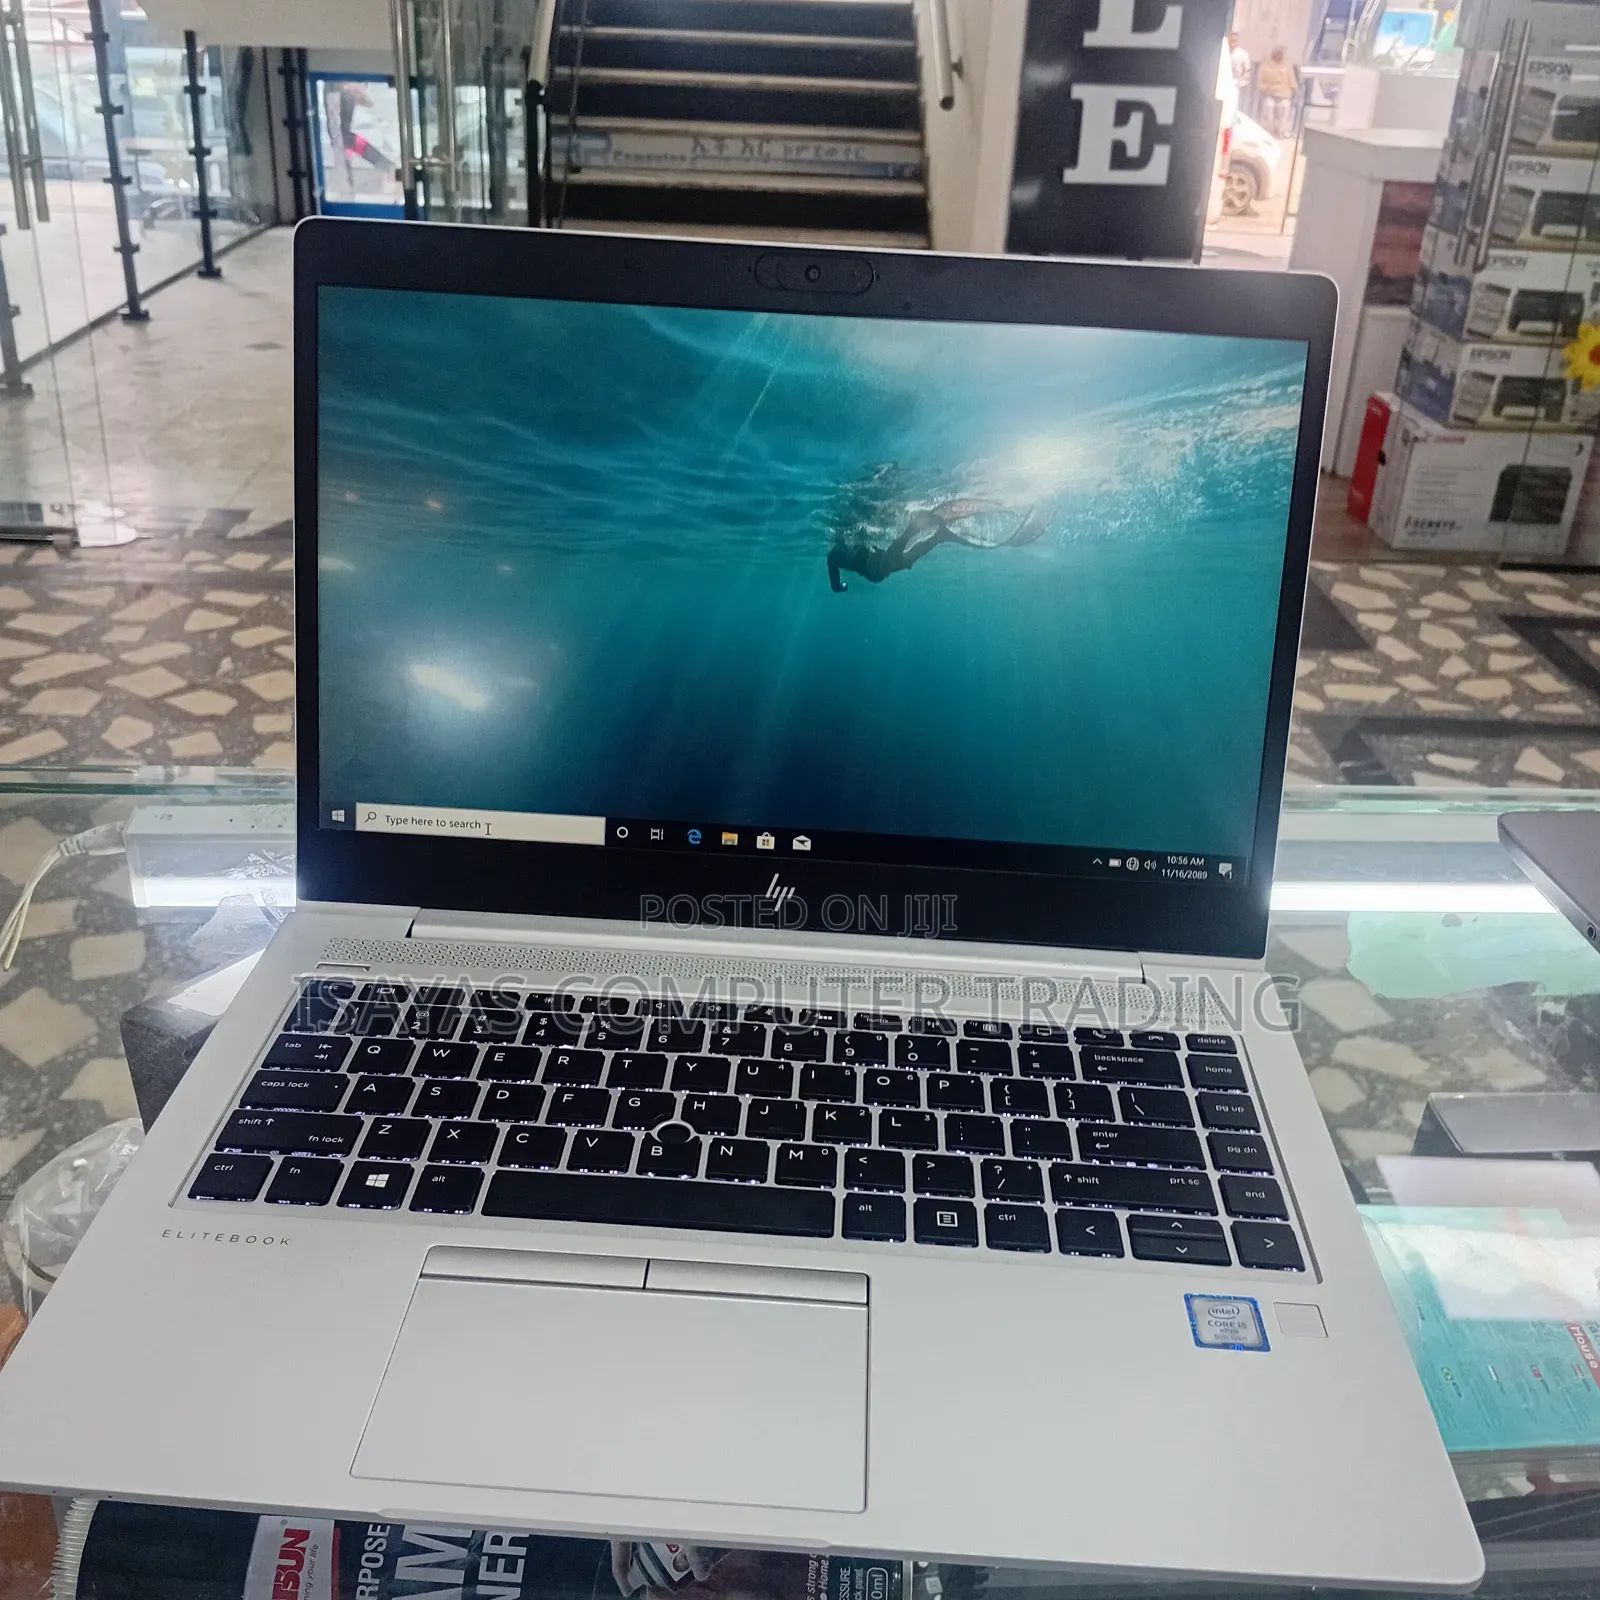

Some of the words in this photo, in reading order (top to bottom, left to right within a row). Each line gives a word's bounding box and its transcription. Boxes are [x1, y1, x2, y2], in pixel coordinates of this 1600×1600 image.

[1527, 60, 1573, 76] EPSON
[1507, 160, 1551, 175] EPSON
[1469, 348, 1512, 363] EPSON
[385, 815, 409, 826] Type
[411, 816, 433, 827] here
[436, 818, 446, 827] to
[449, 818, 481, 830] search
[1166, 855, 1188, 866] 10:56
[1190, 857, 1205, 866] AM
[411, 1021, 422, 1030] 2
[473, 1025, 482, 1034] 3
[597, 1032, 607, 1041] 5
[658, 1035, 668, 1043] 6
[721, 1037, 730, 1046] 7
[1197, 1037, 1227, 1045] delete
[367, 1045, 381, 1055] Q
[783, 1043, 793, 1052] 8
[845, 1047, 855, 1057] 9
[432, 1048, 451, 1058] W
[494, 1052, 506, 1062] E
[557, 1056, 570, 1065] R
[622, 1059, 633, 1069] T
[1094, 1054, 1144, 1064] backspace
[686, 1062, 698, 1072] Y
[747, 1065, 759, 1075] U
[1204, 1065, 1233, 1074] home
[261, 1080, 286, 1090] caps
[287, 1080, 310, 1089] lock
[876, 1075, 891, 1086] O
[939, 1080, 950, 1090] P
[362, 1083, 377, 1093] A
[430, 1086, 442, 1096] S
[496, 1090, 509, 1099] D
[562, 1093, 574, 1103] F
[628, 1097, 641, 1107] G
[694, 1101, 706, 1110] H
[759, 1105, 769, 1115] J
[1215, 1104, 1228, 1113] pg
[1231, 1104, 1245, 1113] up
[825, 1110, 837, 1121] K
[238, 1117, 262, 1126] shift
[891, 1117, 902, 1127] L
[378, 1124, 393, 1135] Z
[447, 1129, 460, 1139] X
[1092, 1129, 1118, 1139] enter
[308, 1135, 319, 1143] fn
[321, 1135, 344, 1144] lock
[516, 1133, 529, 1144] C
[586, 1137, 599, 1148] V
[651, 1146, 663, 1156] B
[720, 1145, 734, 1156] N
[1227, 1146, 1241, 1154] pg
[1243, 1145, 1257, 1154] dn
[789, 1149, 803, 1161] M
[214, 1163, 234, 1171] ctrl
[289, 1167, 300, 1175] fn
[431, 1174, 446, 1183] alt
[1077, 1175, 1100, 1185] shift
[1169, 1176, 1186, 1185] prt
[1188, 1178, 1200, 1186] sc
[1245, 1189, 1265, 1198] end
[858, 1203, 873, 1212] alt
[998, 1212, 1016, 1222] ctrl
[162, 1229, 291, 1245] ELITEBOOK
[1212, 1308, 1236, 1316] intel
[1207, 1319, 1234, 1328] CORE
[1237, 1321, 1248, 1330] i5
[307, 1543, 319, 1558] life
[355, 1524, 391, 1600] RPOSE
[306, 1560, 316, 1580] your
[818, 1559, 829, 1590] Home
[806, 1560, 819, 1594] strong
